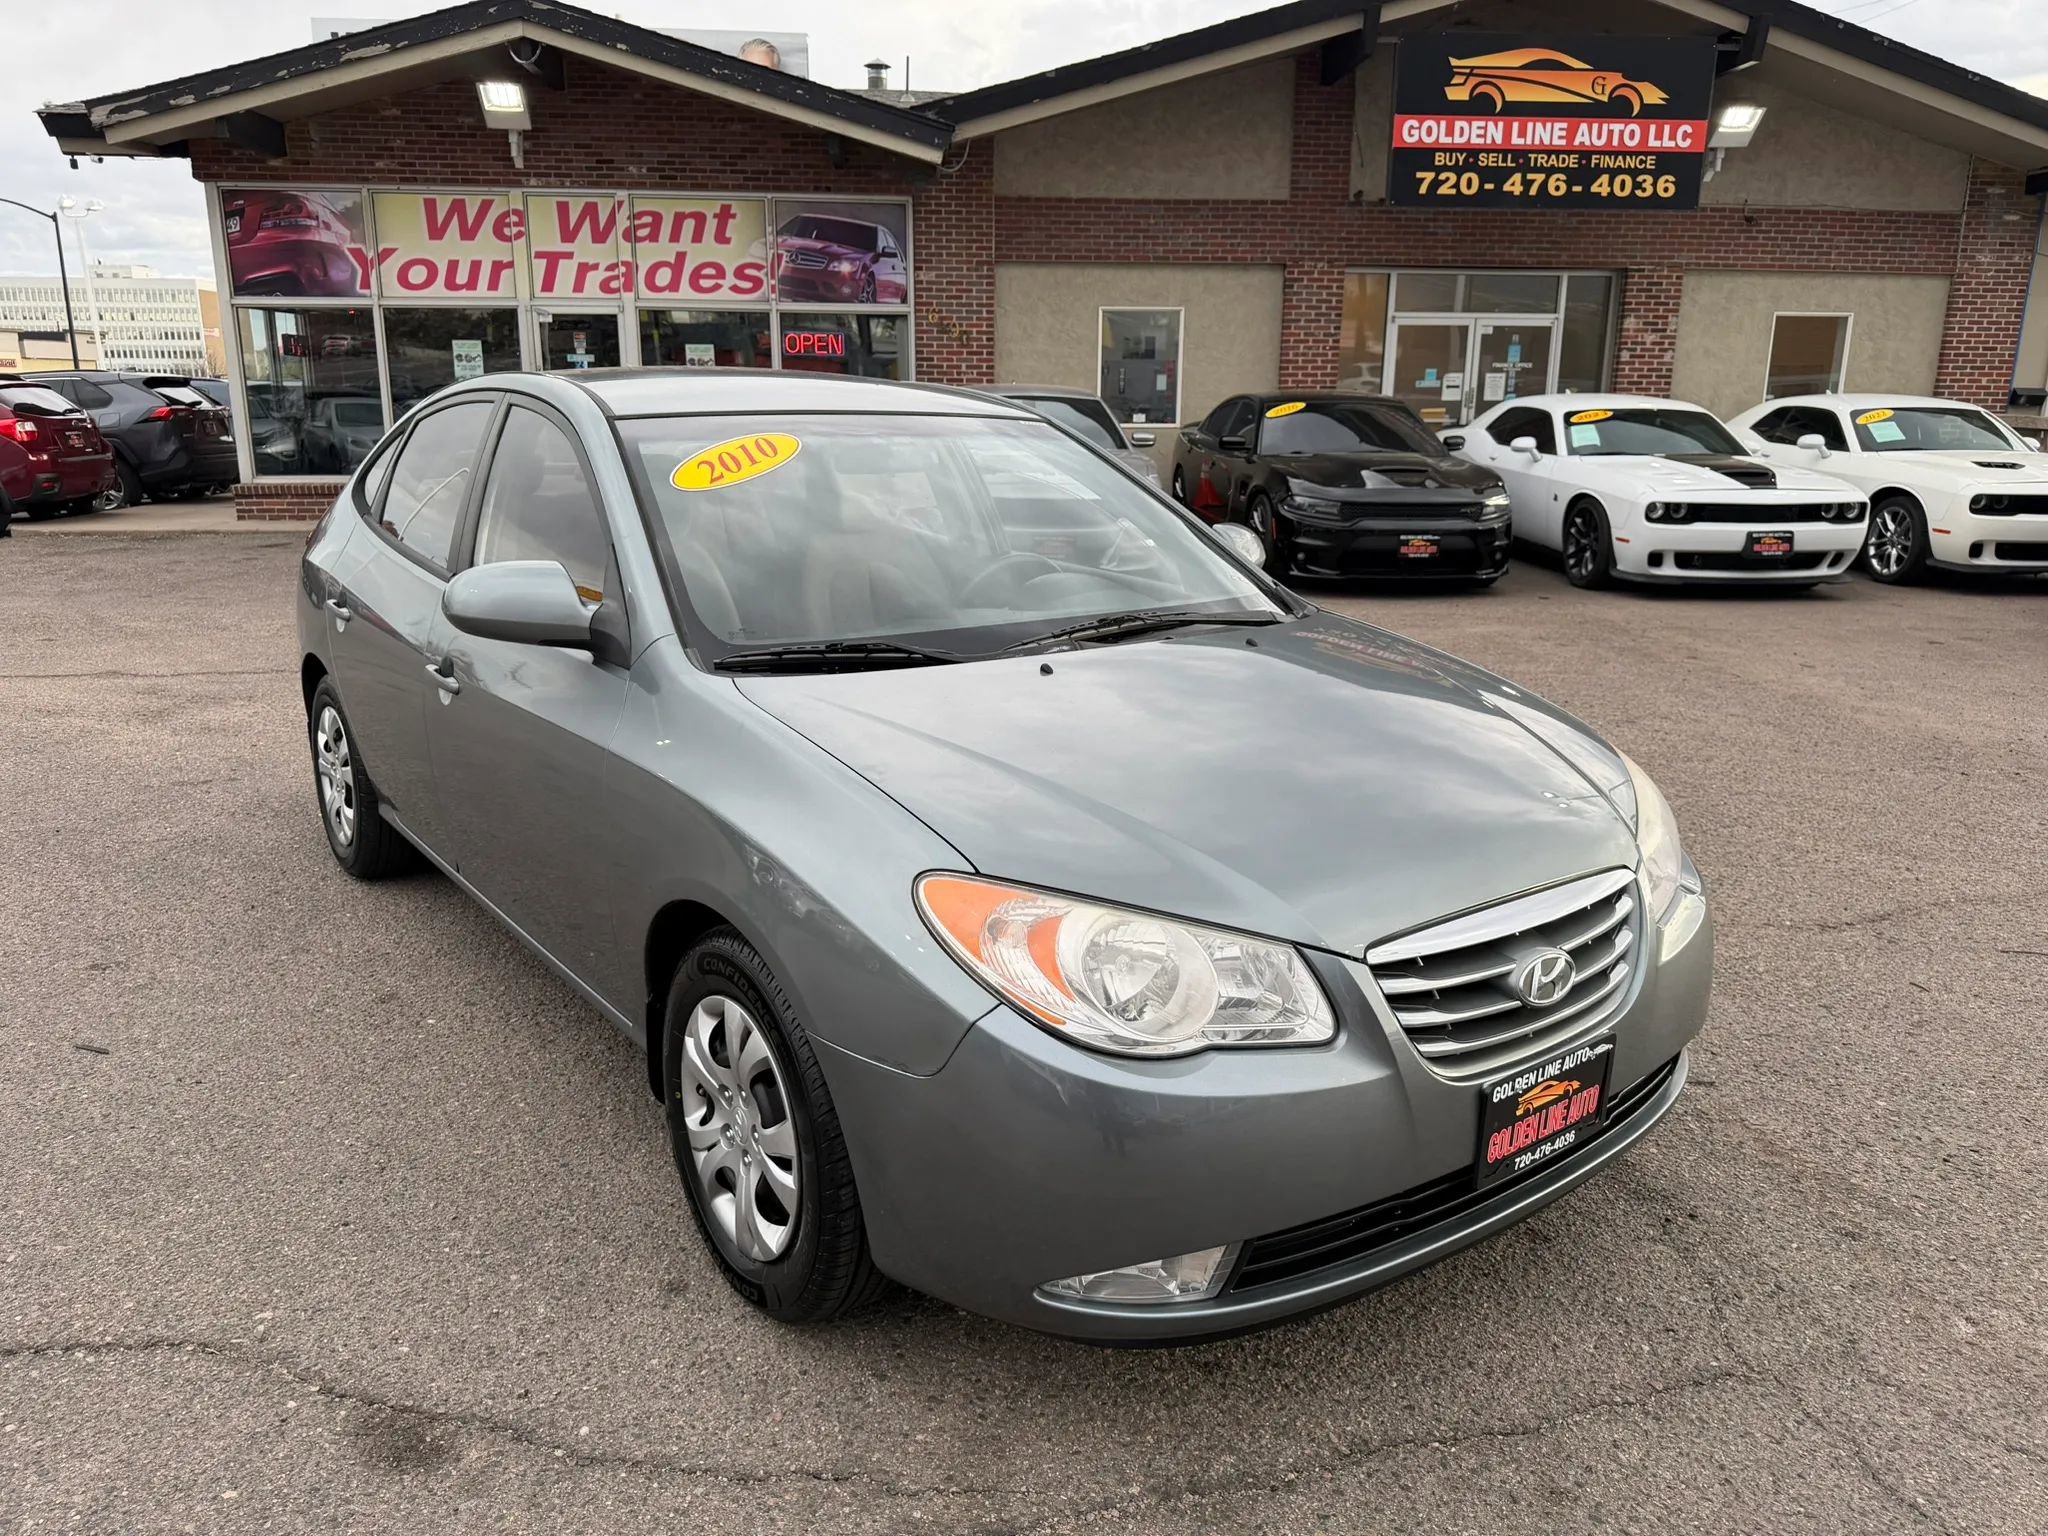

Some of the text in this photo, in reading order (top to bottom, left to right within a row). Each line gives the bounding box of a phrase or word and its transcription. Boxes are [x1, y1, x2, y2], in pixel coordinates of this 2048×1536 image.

[1401, 119, 1693, 148] GOLDEN LINE AUTO LLC
[1434, 152, 1656, 169] BUY SELL TRADE FINANCE
[422, 197, 737, 245] We Want
[346, 247, 784, 296] Your Trades!
[785, 333, 842, 354] OPEN
[696, 437, 778, 484] 2010
[1492, 1047, 1590, 1103] GOLDEN LINE AUTO
[1487, 1085, 1600, 1164] GOLDEN LINE AUTO
[1514, 1130, 1576, 1171] 720-476-4036
